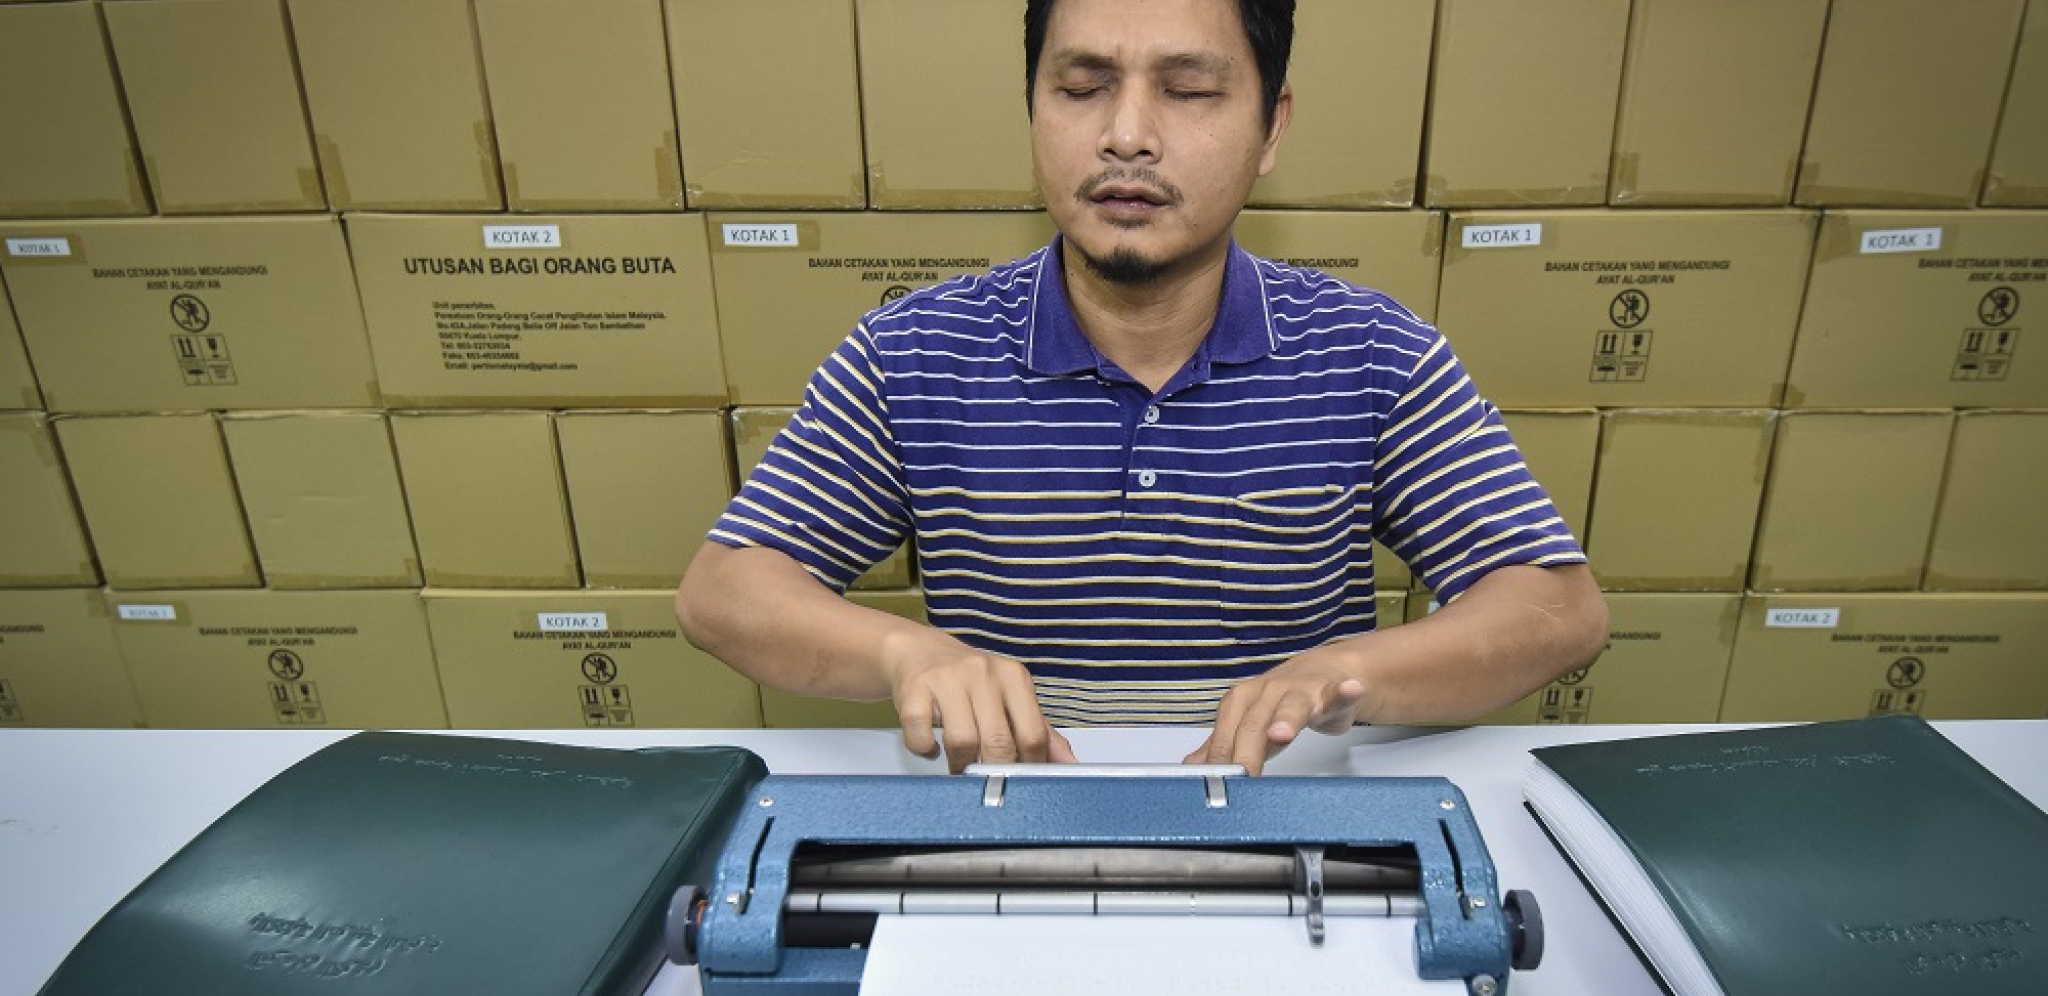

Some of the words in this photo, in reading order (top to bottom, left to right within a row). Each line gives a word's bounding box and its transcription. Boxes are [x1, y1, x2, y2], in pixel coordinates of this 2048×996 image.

[493, 232, 538, 243] KOTAK
[731, 230, 776, 242] KOTAK
[1472, 230, 1518, 243] KOTAK
[1868, 234, 1917, 249] KOTAK
[404, 258, 483, 275] UTUSAN
[490, 258, 538, 274] BAGI
[545, 258, 616, 274] ORANG
[622, 257, 676, 273] BUTA
[809, 259, 842, 267] BAHAN
[844, 259, 889, 267] CETAKAN
[891, 259, 916, 267] YANG
[919, 259, 989, 267] MENGANDUNGI
[1288, 258, 1359, 267] MENGANDUNGI
[1545, 263, 1579, 271] BAHAN
[1582, 262, 1626, 271] CETAKAN
[1630, 261, 1655, 271] YANG
[1659, 261, 1731, 271] MENGANDUNGI
[862, 271, 883, 281] AYAT
[1597, 275, 1620, 284] AYAT
[547, 617, 588, 627] KOTAK
[1774, 613, 1817, 623] KOTAK
